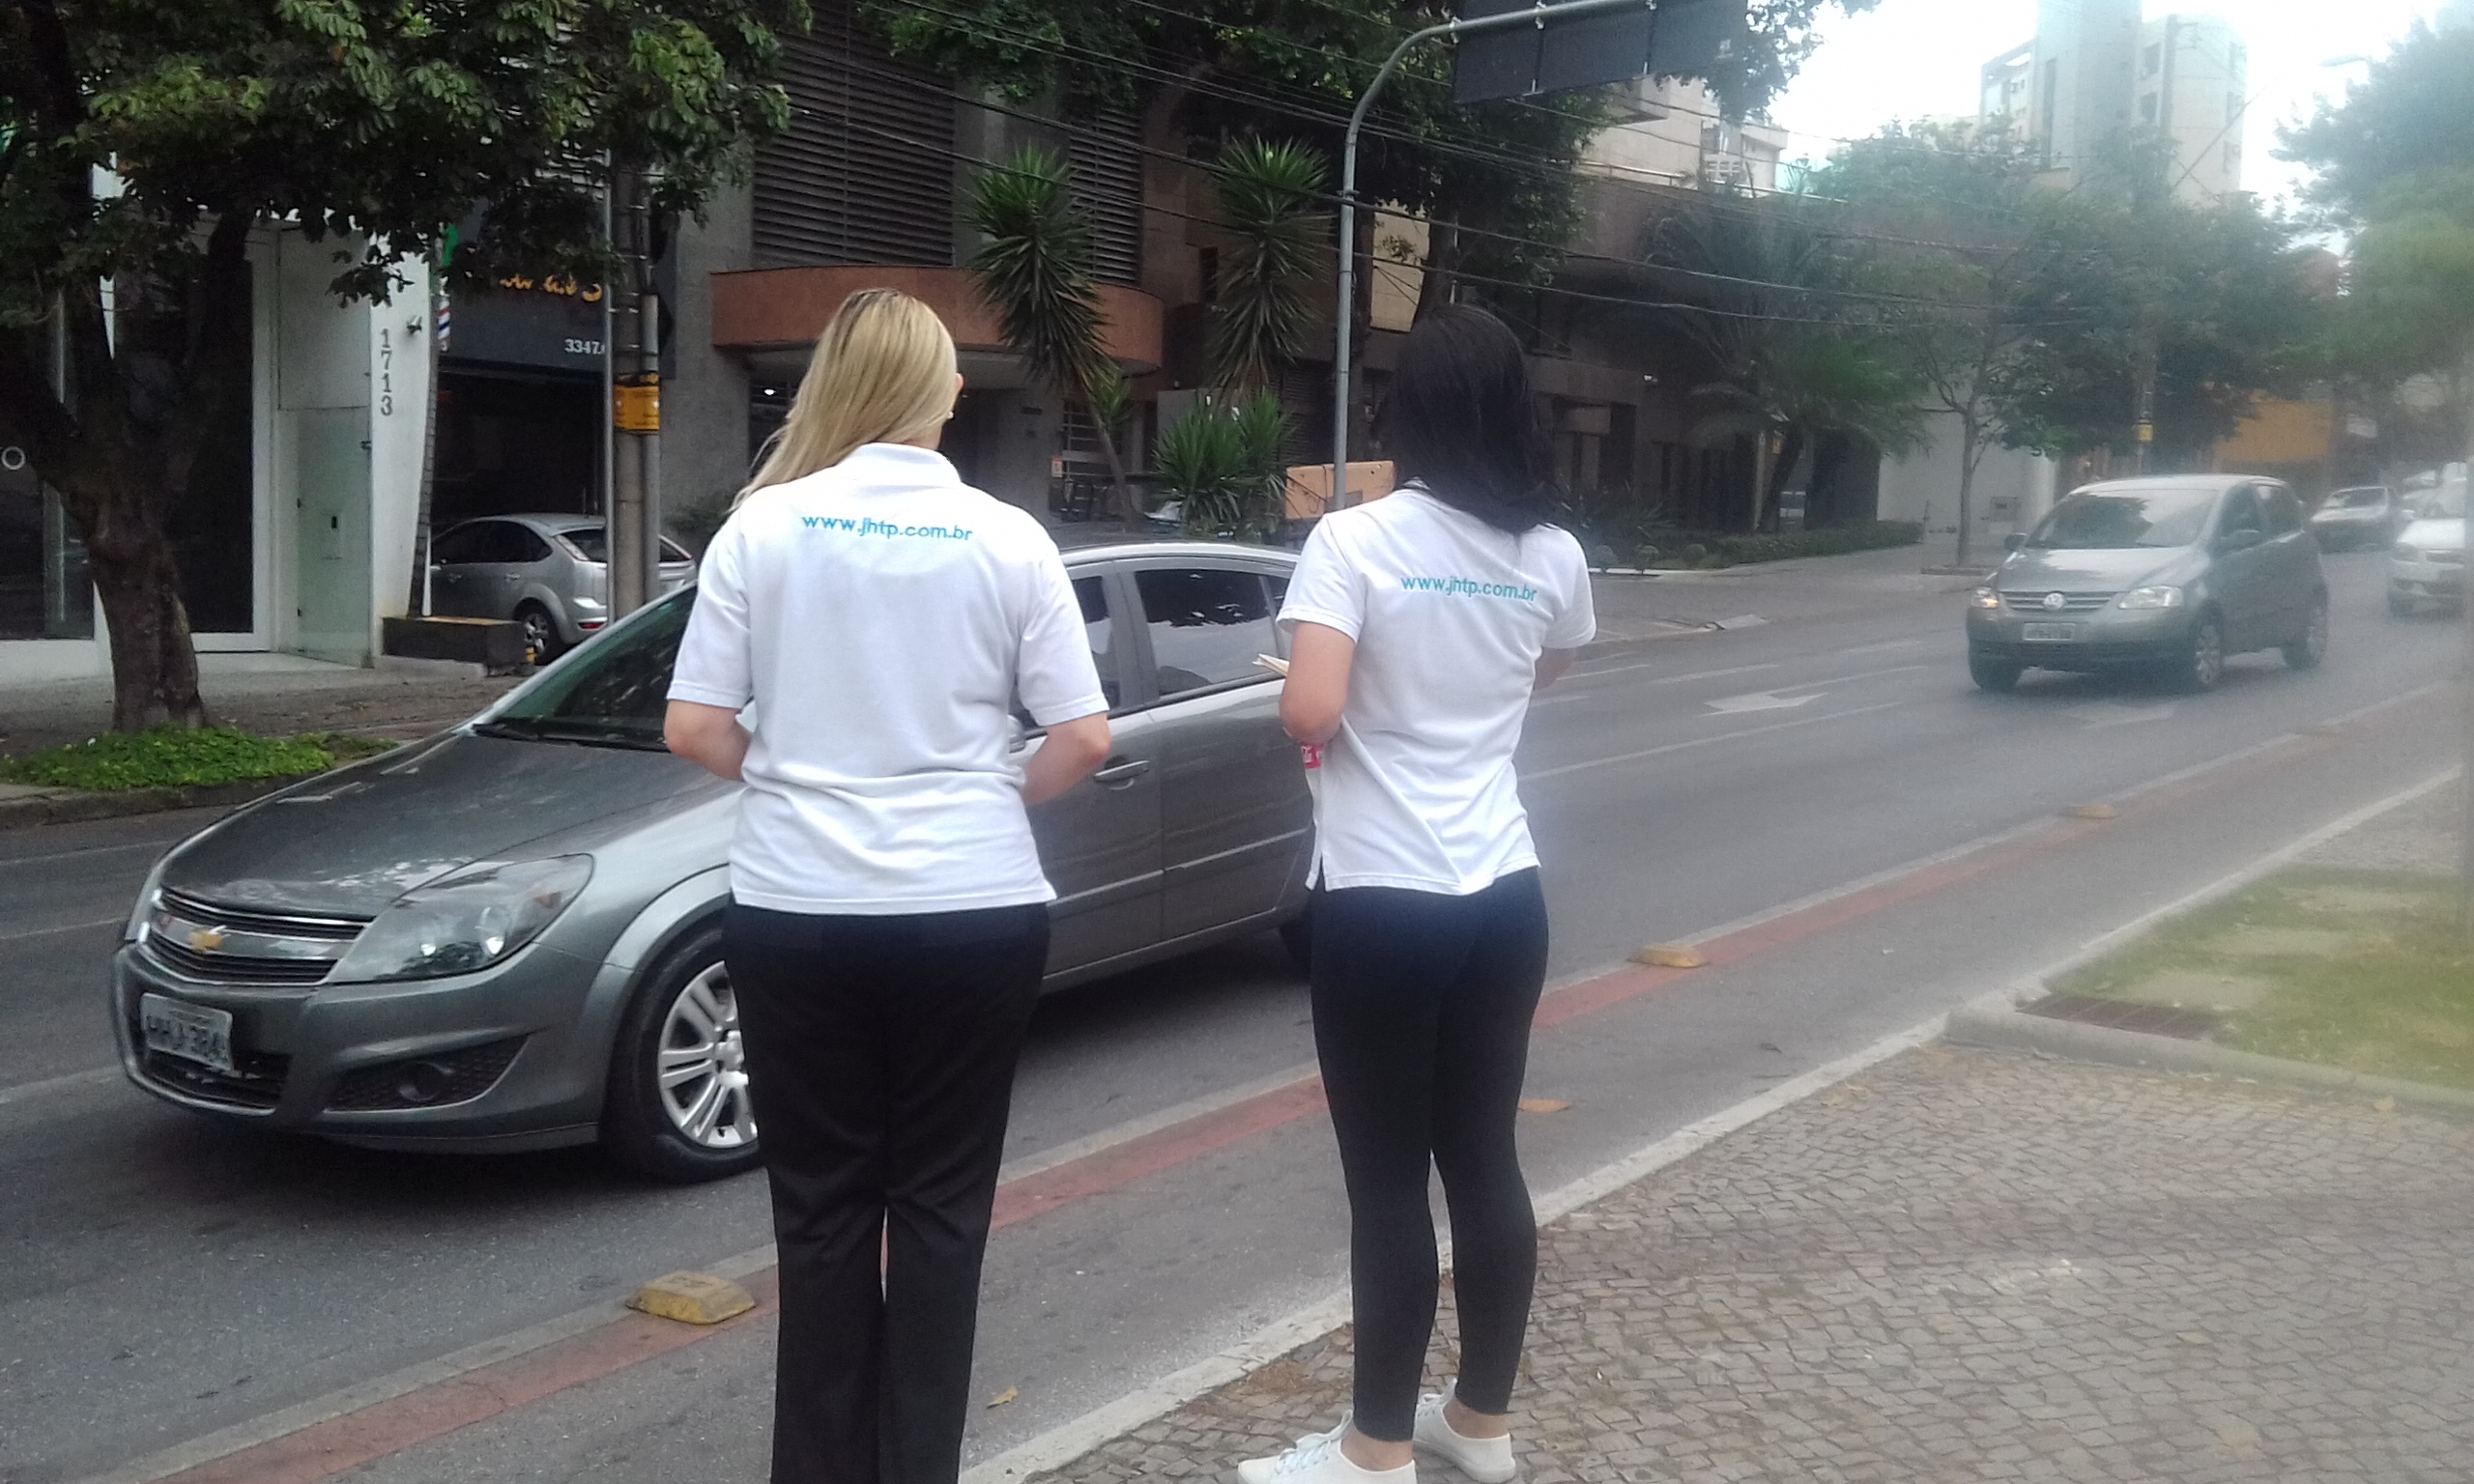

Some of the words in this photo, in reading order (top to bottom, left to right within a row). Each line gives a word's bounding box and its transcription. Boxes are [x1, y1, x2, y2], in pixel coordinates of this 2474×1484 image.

[380, 328, 393, 416] 1713
[801, 516, 973, 540] www.jhtp.com.br
[1401, 576, 1538, 602] www.jhtp.com.br
